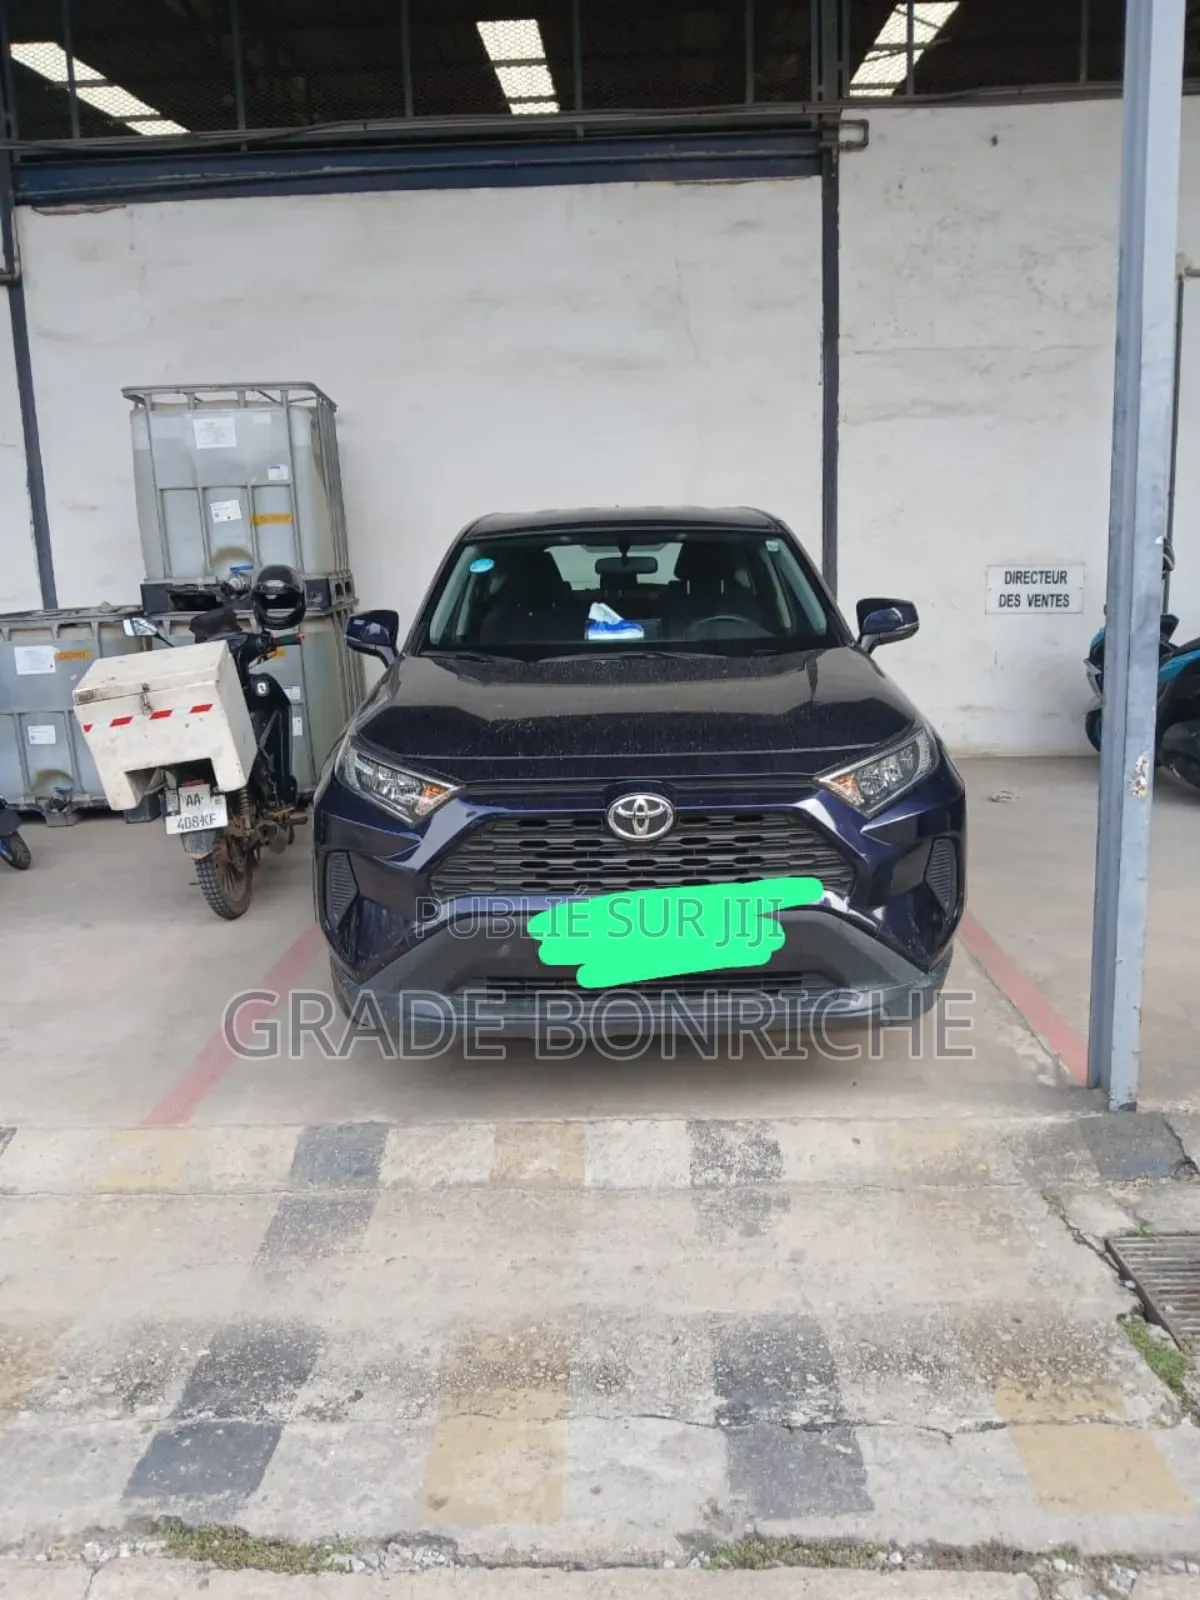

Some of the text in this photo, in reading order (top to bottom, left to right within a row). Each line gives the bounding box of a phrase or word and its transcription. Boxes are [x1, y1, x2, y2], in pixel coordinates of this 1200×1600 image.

[1004, 570, 1067, 585] DIRECTEUR
[998, 594, 1070, 608] DES VENTES
